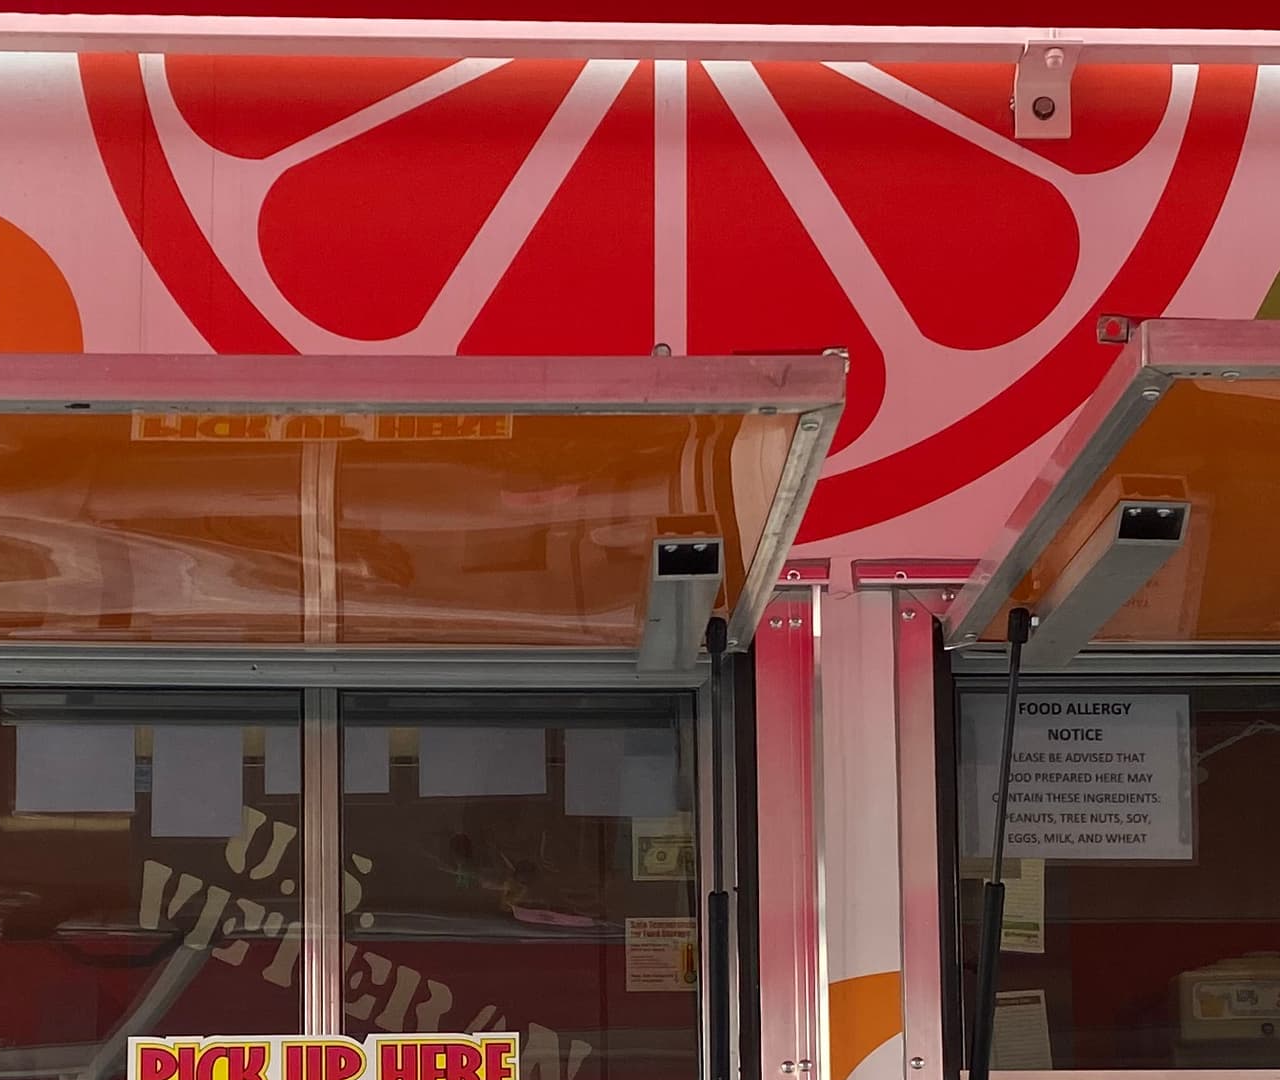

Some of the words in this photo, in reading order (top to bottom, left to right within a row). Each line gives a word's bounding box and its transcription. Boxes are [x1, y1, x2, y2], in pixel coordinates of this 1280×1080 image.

[1019, 702, 1062, 715] FOOD
[1066, 702, 1131, 715] ALLERGY
[1047, 728, 1103, 741] NOTICE
[1048, 752, 1062, 763] BE
[1065, 752, 1114, 763] ADVISED
[1116, 752, 1146, 763] THAT
[1034, 772, 1092, 783] PREPARED
[1095, 772, 1124, 783] HERE
[1127, 772, 1153, 783] MAY
[992, 792, 1043, 803] CNTAIN
[1046, 792, 1080, 803] THESE
[1083, 792, 1161, 803] INGREDIENTS:
[1060, 813, 1087, 824] TREE
[1090, 813, 1123, 825] NUTS,
[1126, 813, 1152, 825] SOY,
[1008, 833, 1041, 845] EGGS,
[1044, 833, 1074, 845] MILK,
[1078, 833, 1103, 844] AND
[1105, 833, 1147, 844] WHEAT
